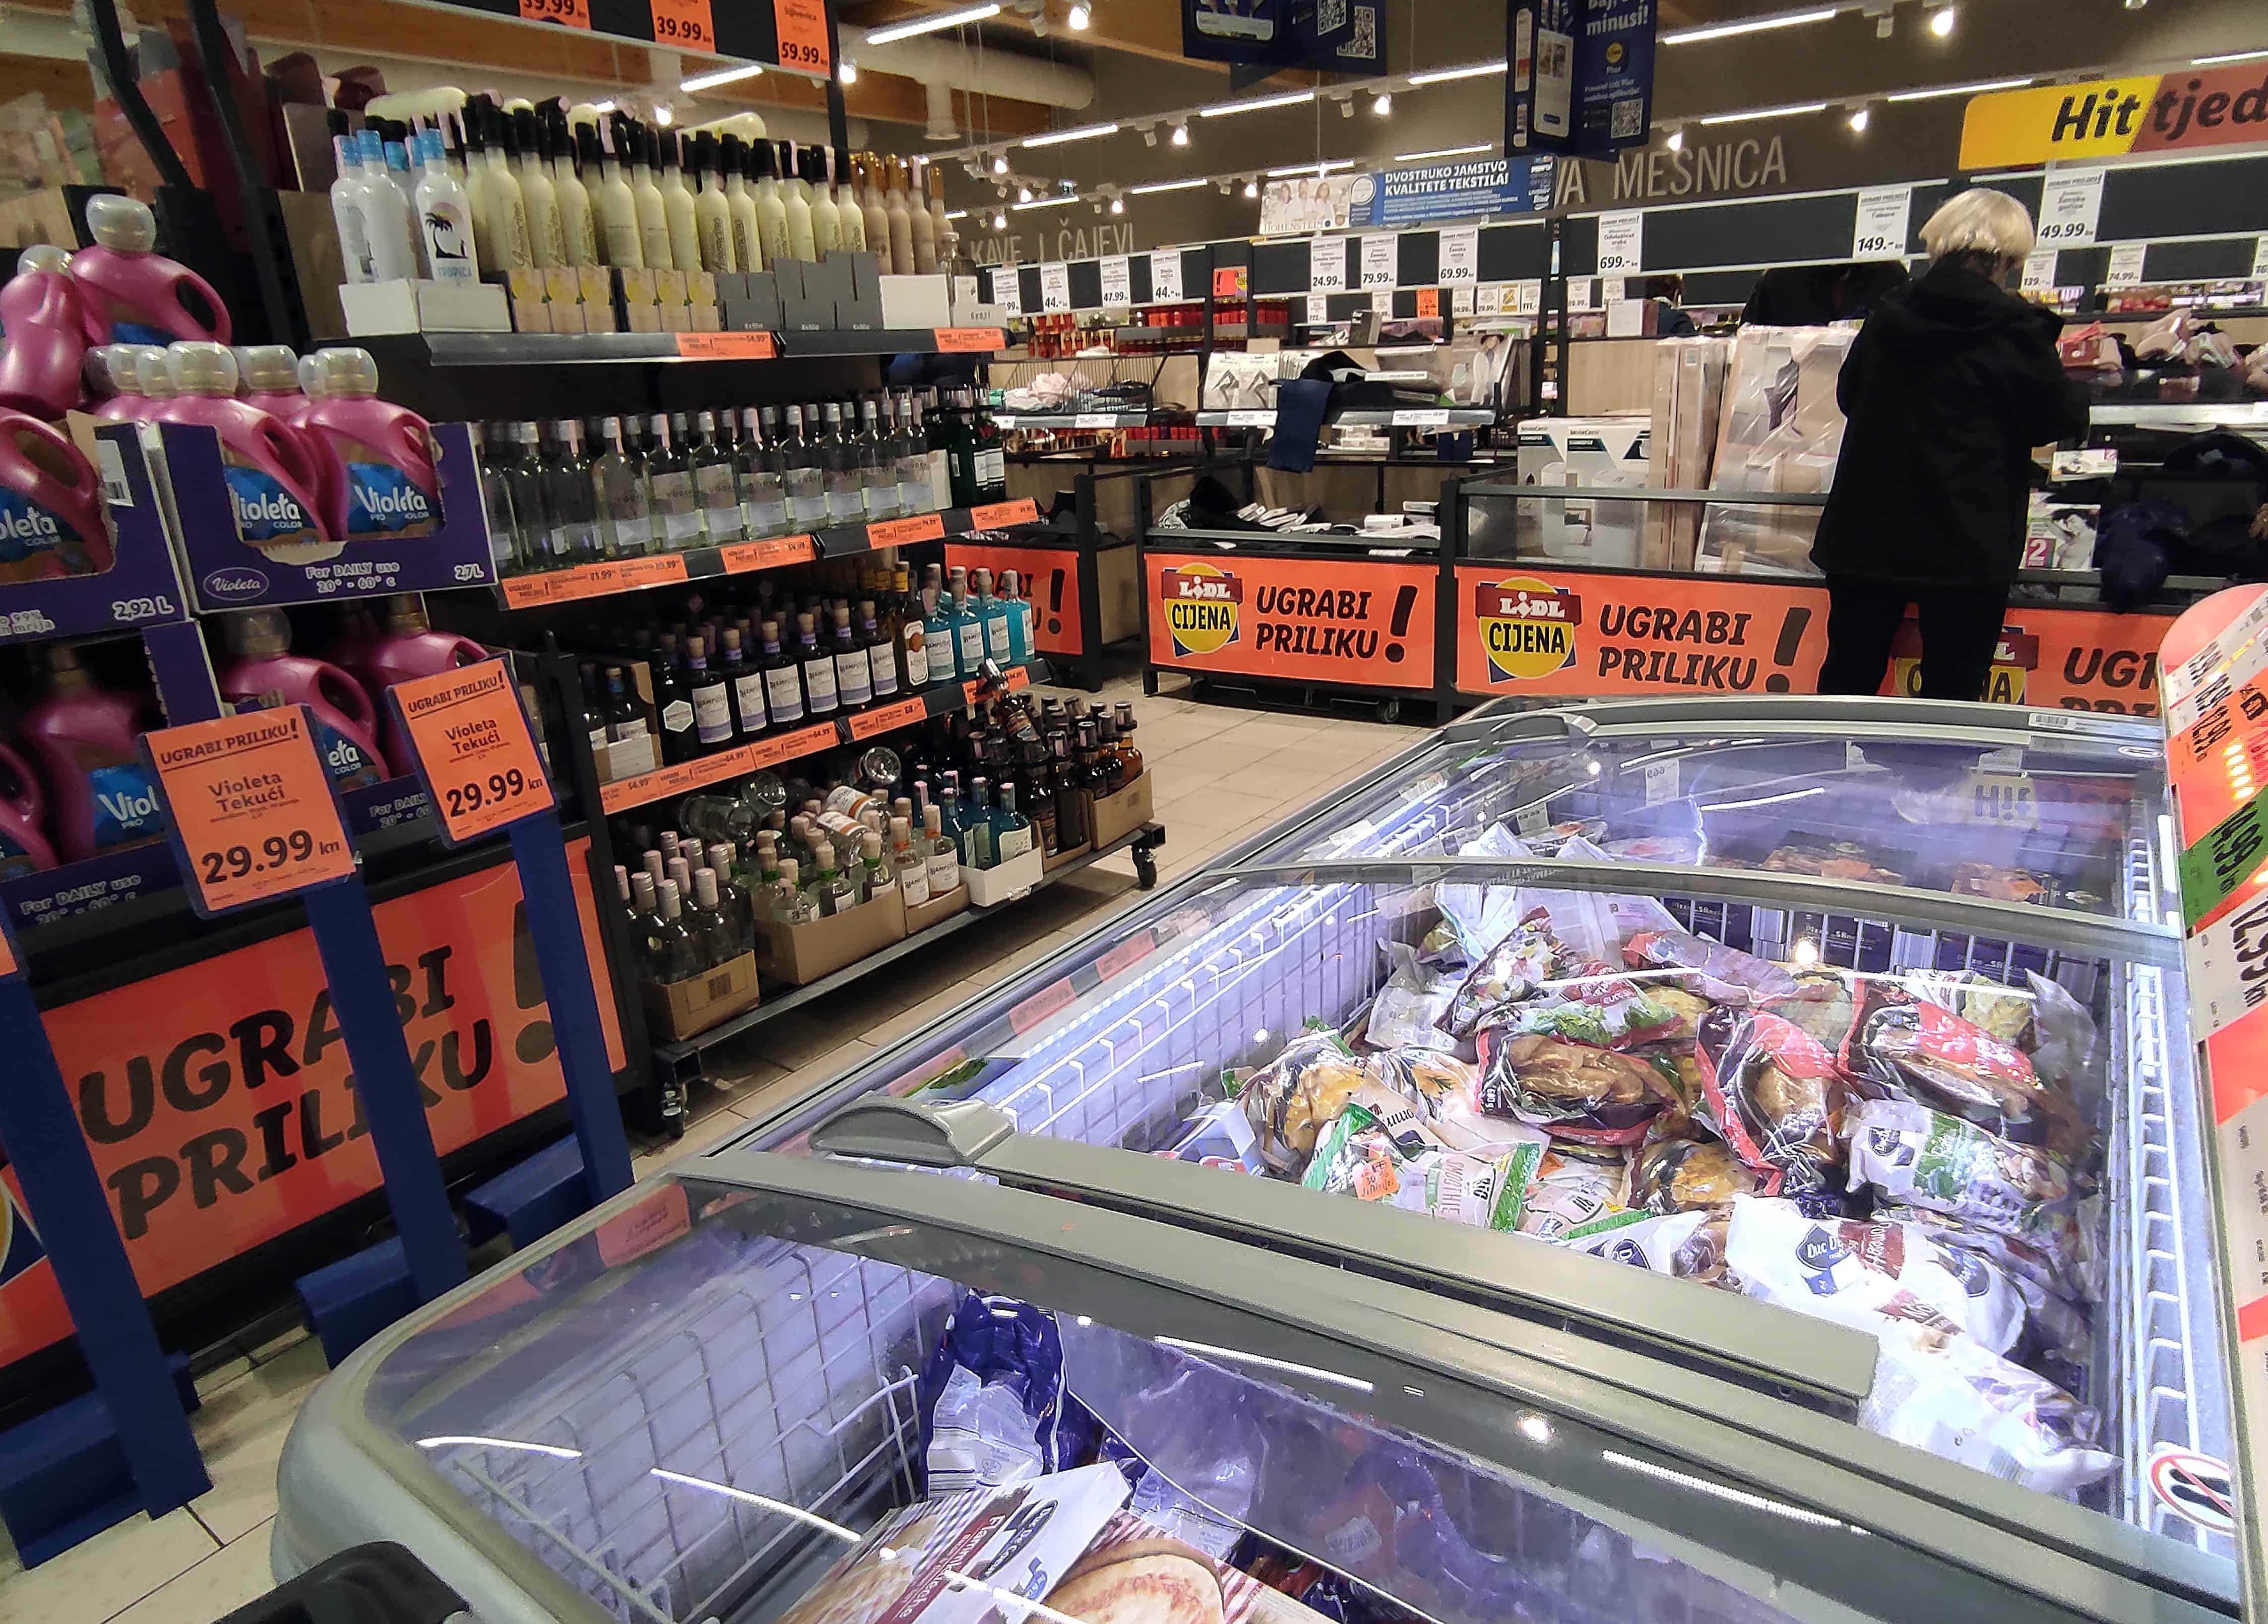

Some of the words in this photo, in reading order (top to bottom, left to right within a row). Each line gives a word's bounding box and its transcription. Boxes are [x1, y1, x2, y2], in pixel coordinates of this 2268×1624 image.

[657, 16, 701, 40] 39.99
[1587, 5, 1649, 36] minusi!
[782, 42, 819, 64] 59.99
[2052, 88, 2140, 142] Hit
[1385, 167, 1452, 183] DVOSTRUKO
[1454, 160, 1507, 175] JAMSTVO
[1613, 136, 1786, 200] MESNICA
[1385, 180, 1446, 196] KVALITETE
[1449, 172, 1509, 189] TEKSTILA!
[971, 234, 1021, 264] KAVE
[1059, 218, 1134, 260] ČAJEVI
[2040, 223, 2085, 238] 49.99
[1858, 237, 1894, 252] 149.-
[1440, 268, 1468, 279] 69.99
[1600, 257, 1630, 269] 699.-
[1313, 276, 1338, 286] 24.99
[1363, 272, 1388, 283] 79.99
[353, 484, 428, 513] Violeta
[305, 566, 331, 579] For
[333, 562, 373, 577] DAILY
[374, 561, 400, 573] use
[212, 576, 261, 592] Violeta
[1179, 575, 1230, 601] LIDL
[1256, 586, 1372, 620] UGRABI
[1499, 591, 1565, 619] LIDL
[1171, 604, 1231, 631] CIJENA
[1599, 604, 1752, 646] UGRABI
[1255, 622, 1378, 659] PRILIKU
[1489, 622, 1566, 654] CIJENA
[1598, 646, 1757, 691] PRILIKU
[408, 690, 452, 713] UGRABI
[454, 670, 506, 699] PRILIKU!
[161, 742, 223, 766] UGRABI
[224, 717, 301, 749] PRILIKU!
[445, 718, 497, 741] Violeta
[452, 729, 501, 756] Tekući
[208, 771, 283, 797] Violeta
[446, 768, 524, 818] 29.99
[528, 777, 543, 791] kn
[98, 785, 160, 823] Viol
[216, 785, 285, 814] Tekući
[202, 829, 313, 885] 29.99
[54, 881, 107, 906] DAILY
[110, 875, 142, 891] use
[1806, 1239, 1827, 1260] Duc
